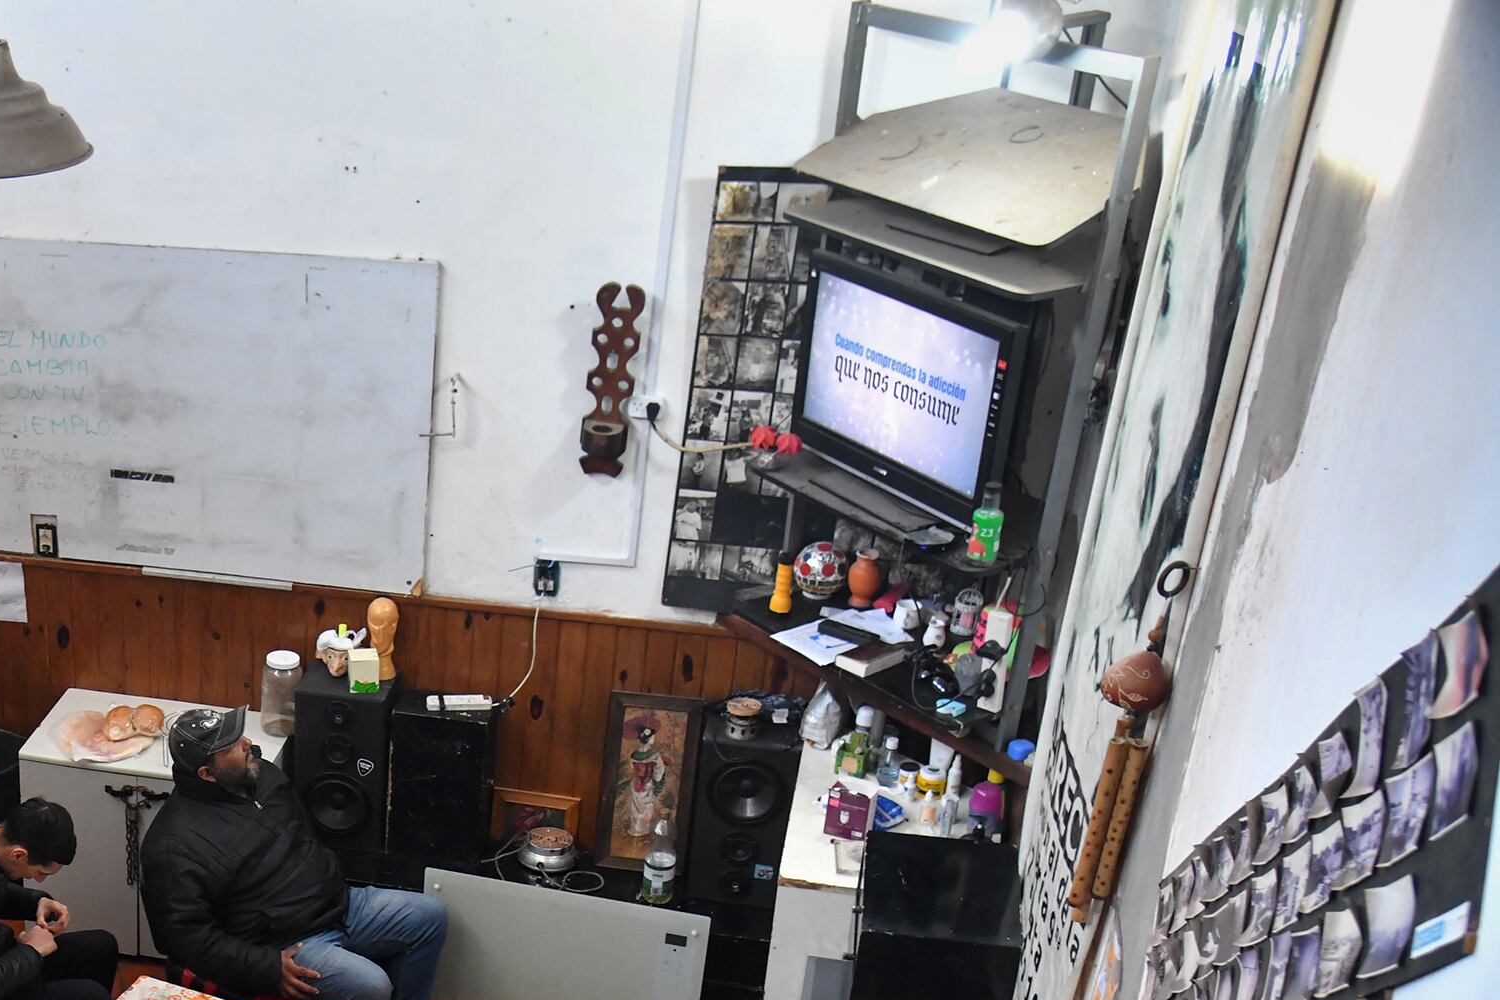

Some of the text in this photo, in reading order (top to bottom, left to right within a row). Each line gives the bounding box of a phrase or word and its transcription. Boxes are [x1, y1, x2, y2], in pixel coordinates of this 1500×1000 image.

[31, 330, 105, 350] MUNDO
[835, 333, 967, 401] Cuando comprendas la adicción
[1, 383, 85, 402] CON TU
[834, 355, 960, 426] que nos consume
